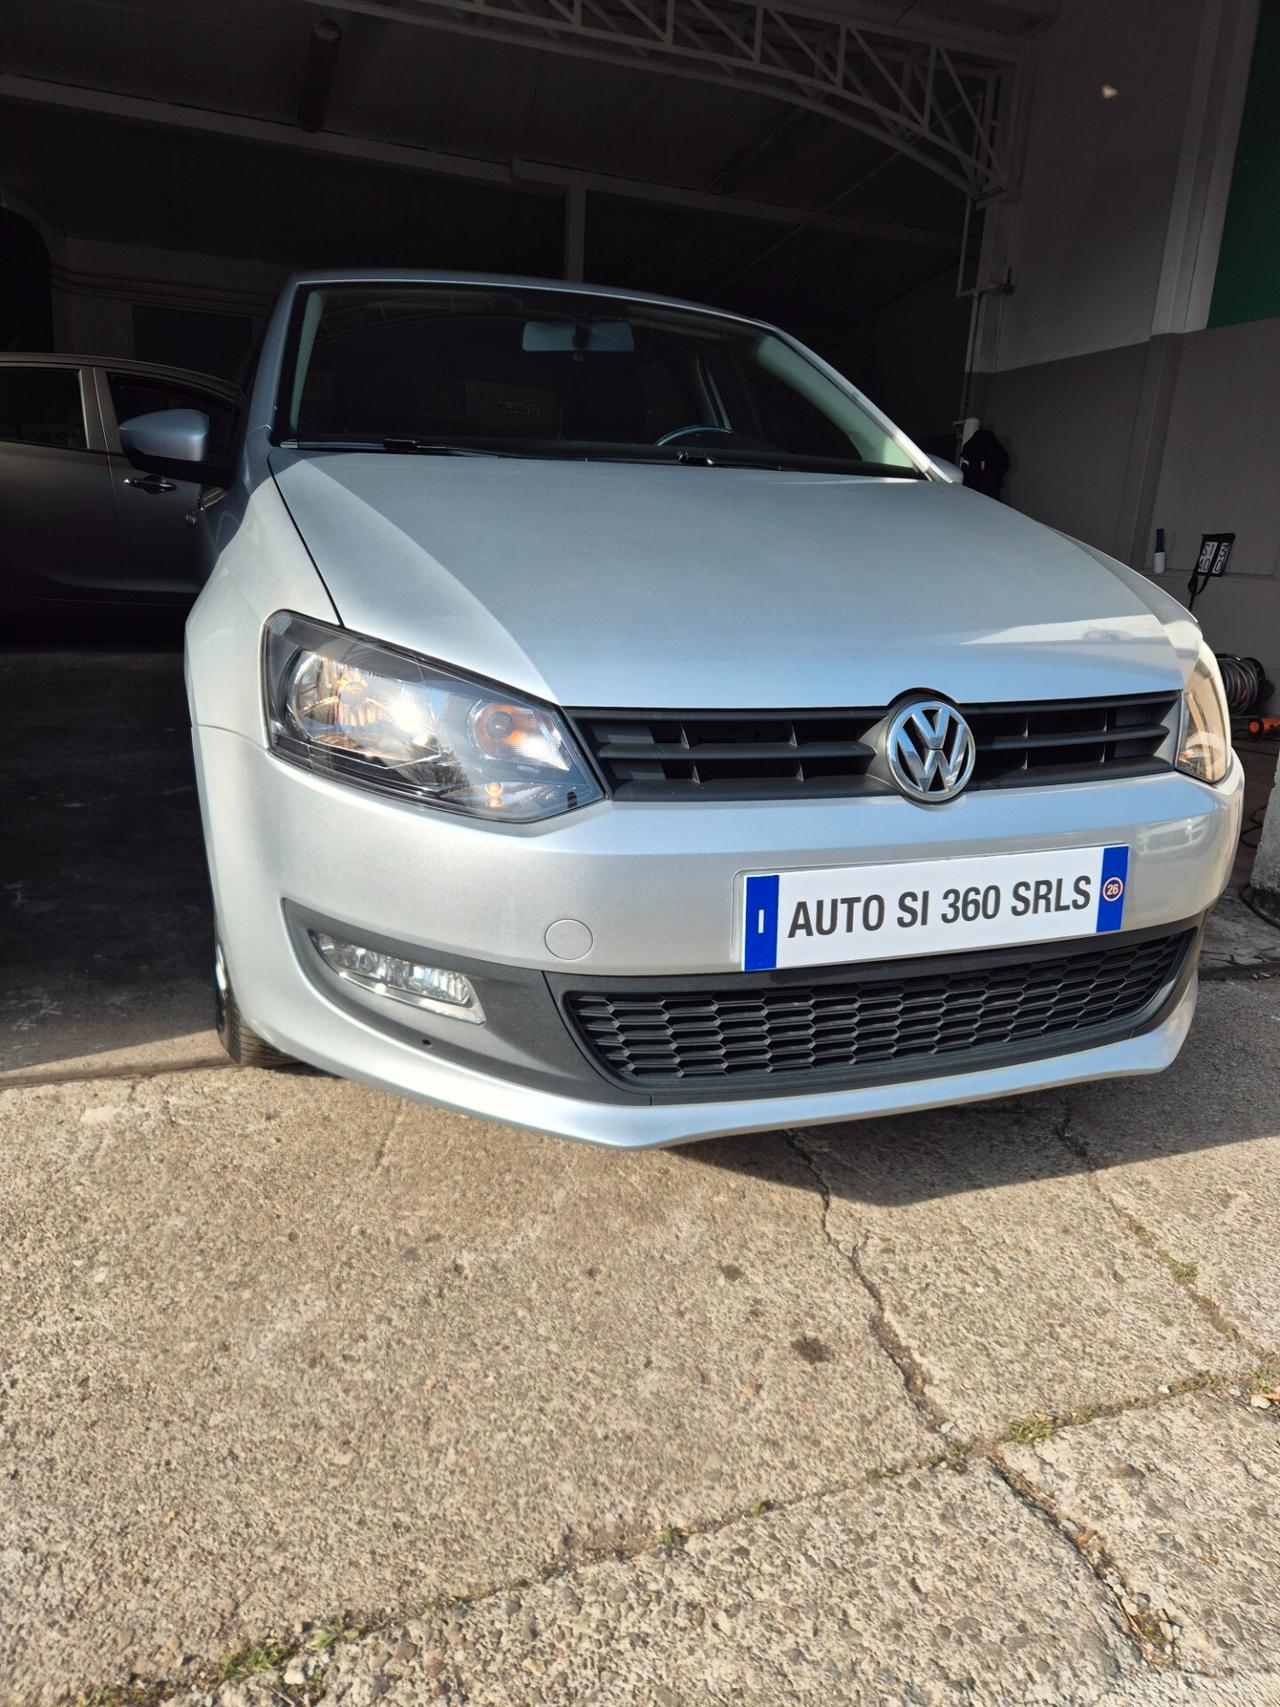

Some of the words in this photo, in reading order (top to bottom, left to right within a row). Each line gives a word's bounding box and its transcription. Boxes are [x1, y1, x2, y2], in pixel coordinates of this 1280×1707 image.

[787, 894, 885, 938] AUTO
[896, 891, 930, 928] SI
[940, 884, 1001, 924] 360
[1010, 875, 1092, 917] SRLS
